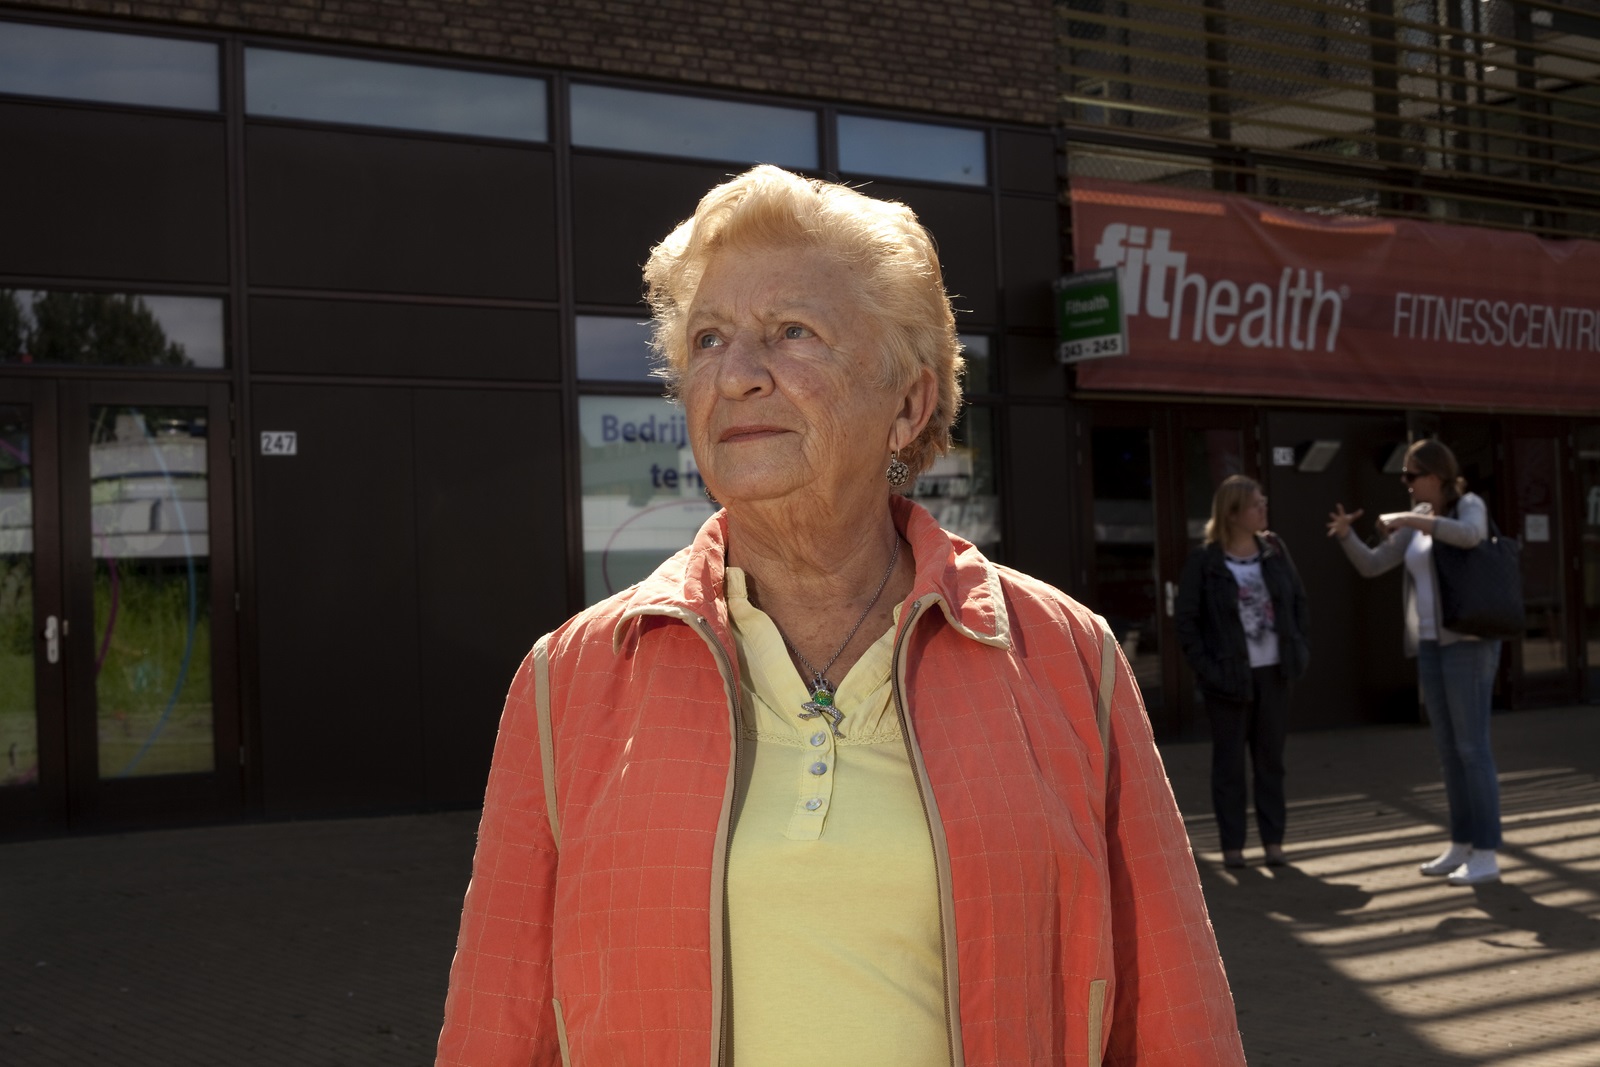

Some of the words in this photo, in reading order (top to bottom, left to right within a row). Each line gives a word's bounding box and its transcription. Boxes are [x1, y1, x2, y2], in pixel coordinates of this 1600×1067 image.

[1093, 338, 1118, 353] 245
[602, 414, 687, 449] Bedrij
[263, 434, 294, 452] 247
[651, 464, 678, 488] te
